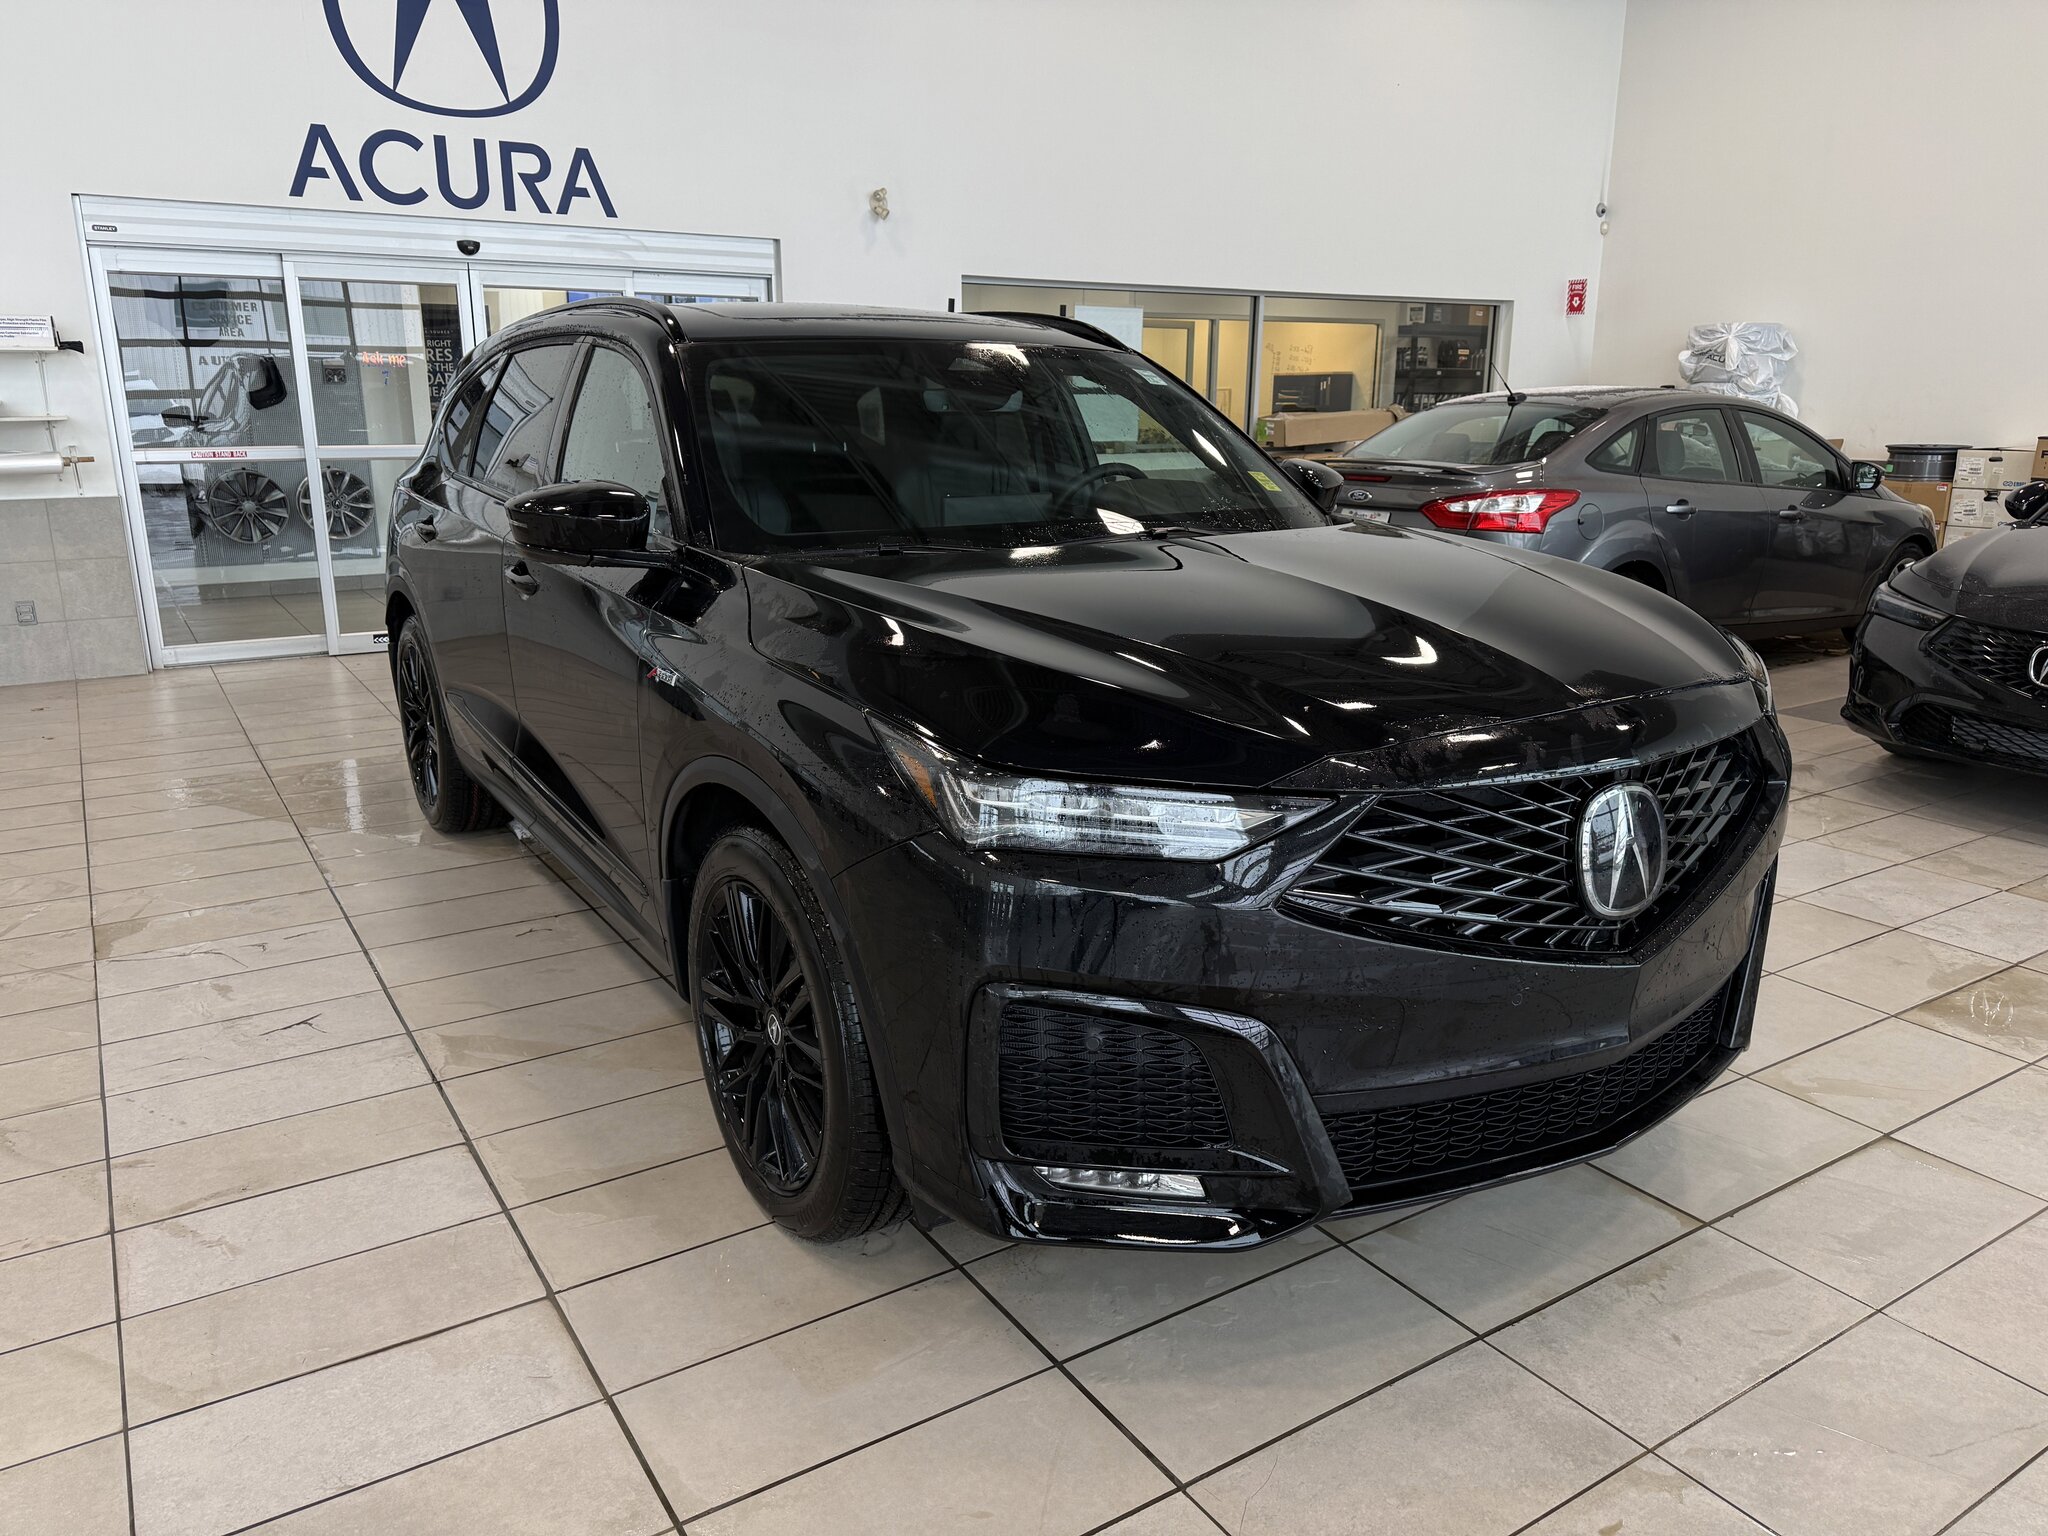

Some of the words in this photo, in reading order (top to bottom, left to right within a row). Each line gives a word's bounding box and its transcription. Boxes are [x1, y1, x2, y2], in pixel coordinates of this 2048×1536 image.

[288, 122, 618, 218] ACURA
[219, 327, 246, 338] AREA
[426, 348, 453, 362] RES
[1705, 354, 1726, 363] ACU
[434, 363, 454, 372] THE
[427, 372, 453, 385] OAD
